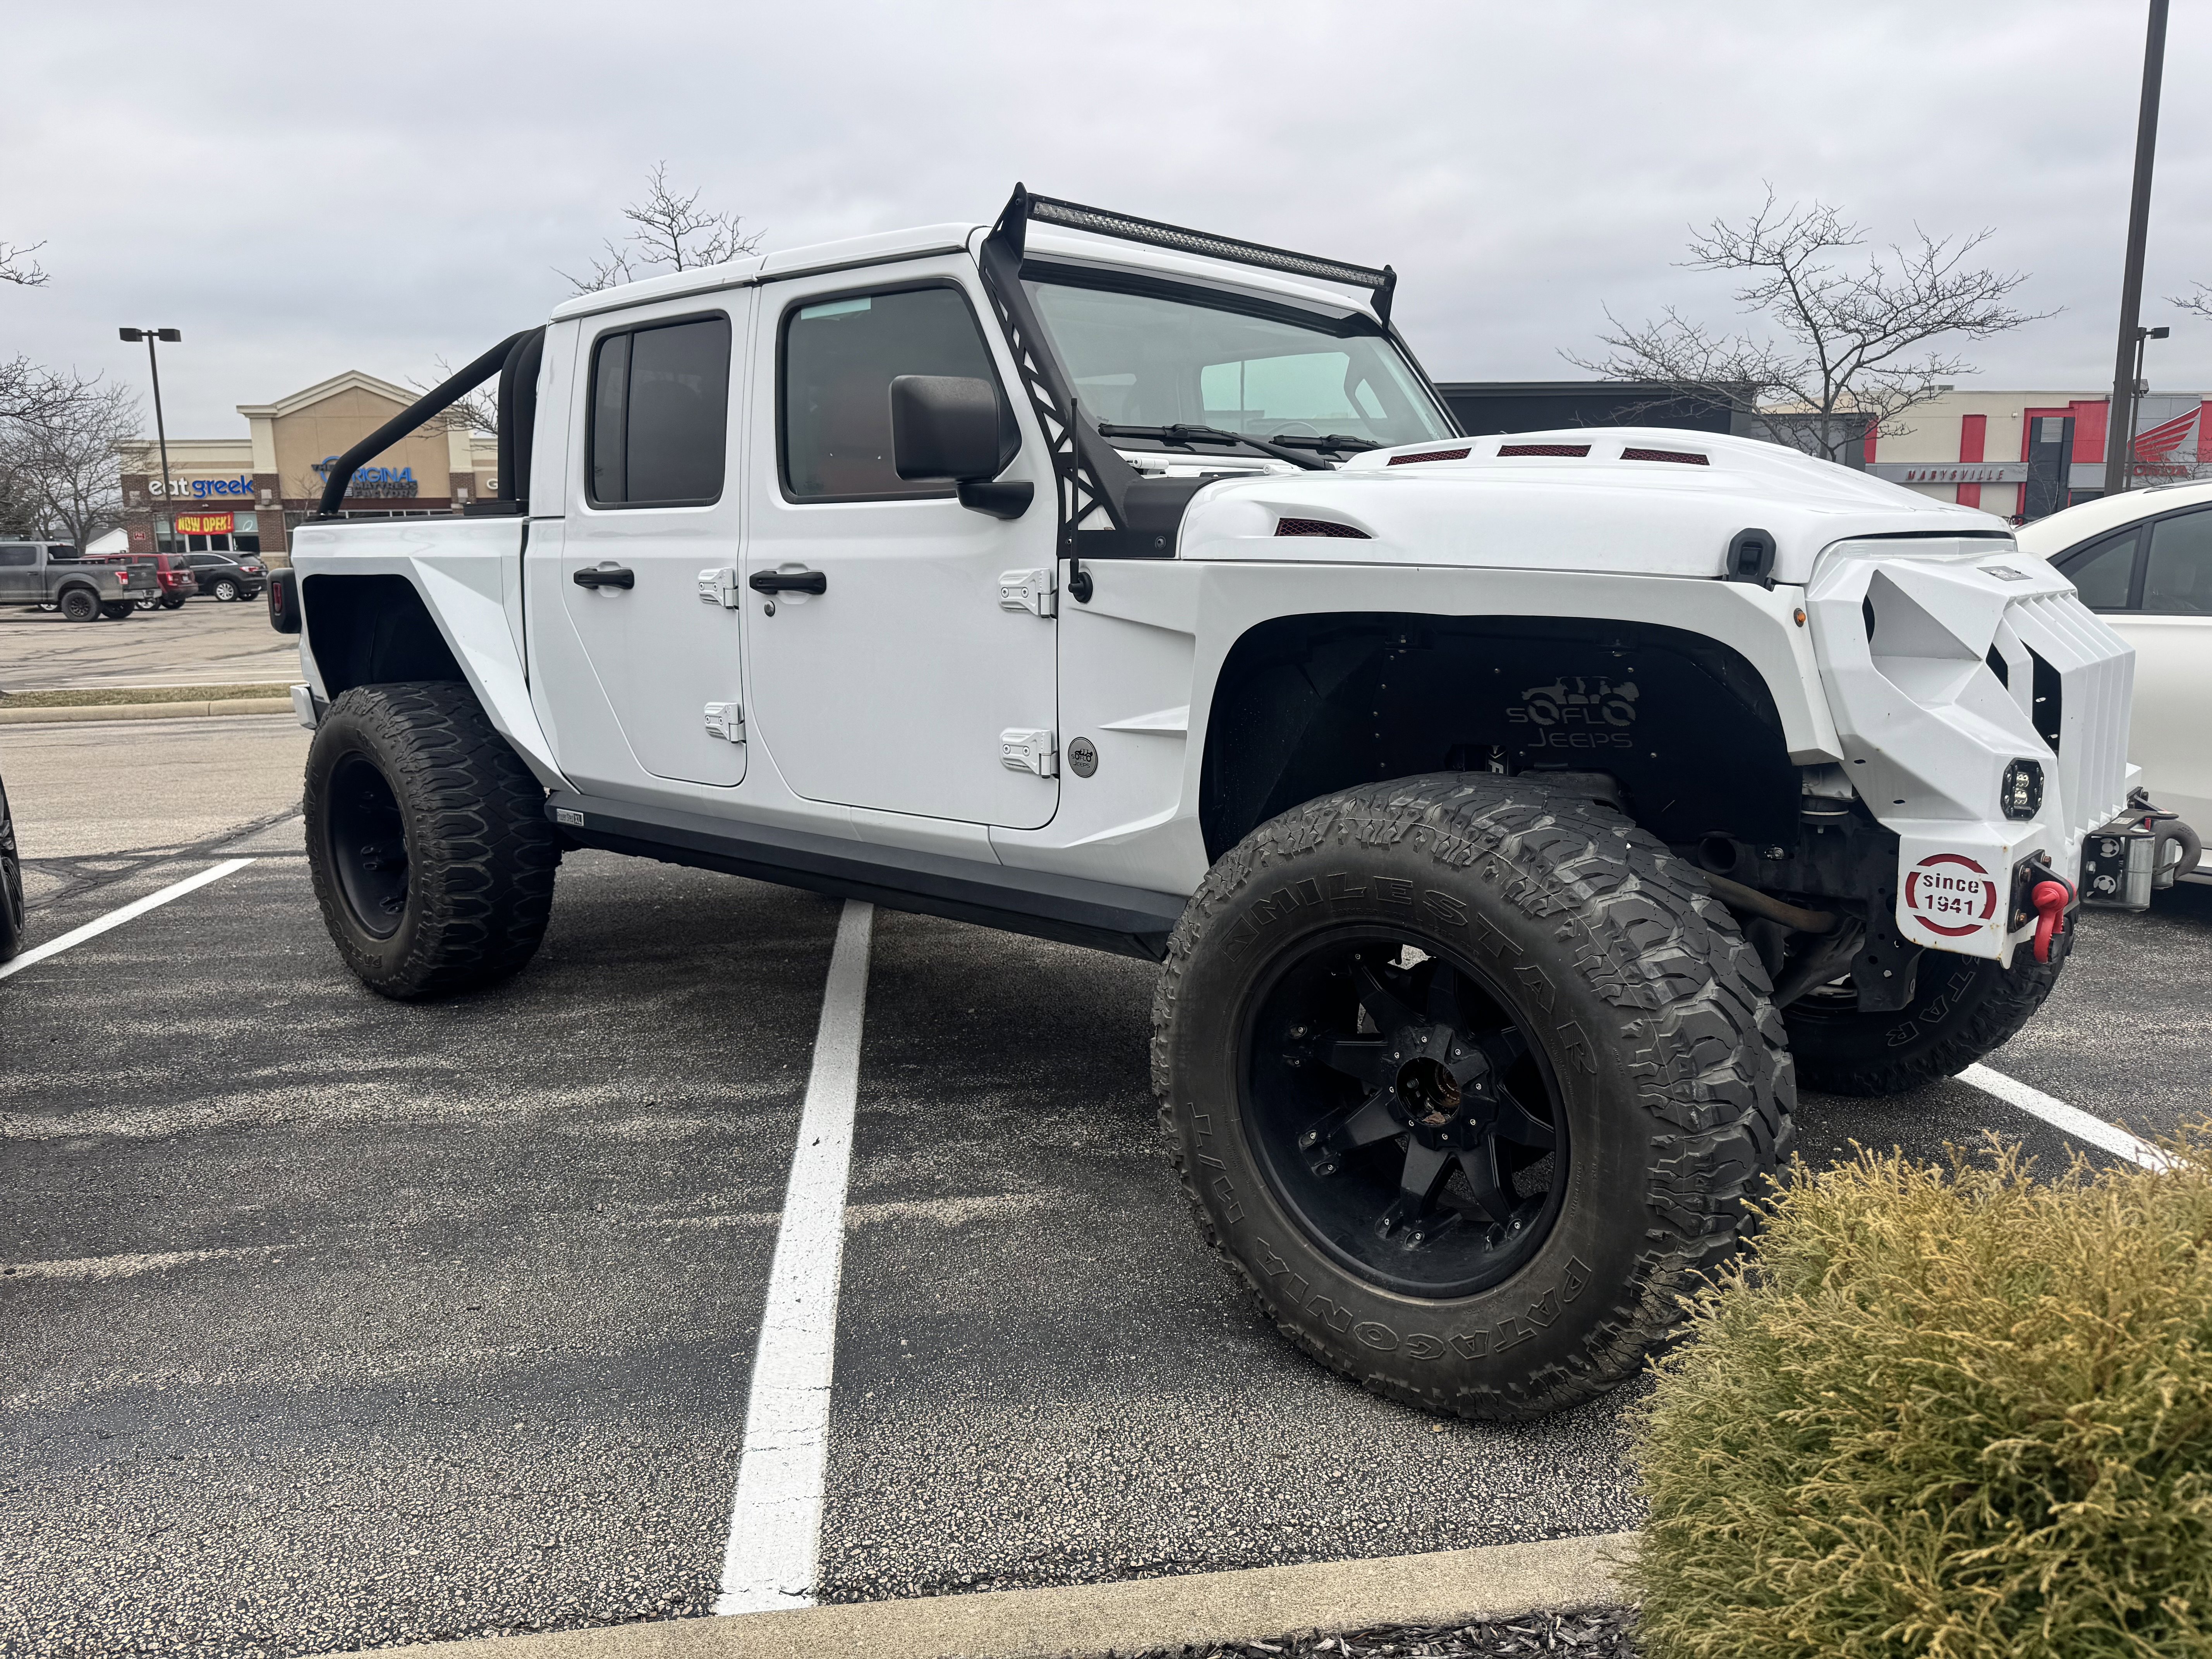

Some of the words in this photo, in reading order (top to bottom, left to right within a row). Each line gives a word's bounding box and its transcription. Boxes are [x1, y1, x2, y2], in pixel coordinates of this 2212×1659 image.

[1906, 470, 2003, 481] MARYSVILLE
[2124, 465, 2188, 477] ONDA
[149, 477, 189, 496] eat
[192, 475, 254, 498] greek
[178, 516, 200, 532] NOW
[203, 515, 231, 532] OPEN!
[1528, 728, 1633, 748] JEEPS
[574, 814, 582, 824] XL
[1923, 873, 1979, 893] since
[1925, 895, 1973, 915] 1941
[1250, 872, 1597, 1075] MILESTAR
[1256, 1237, 1592, 1360] PATAGONIA
